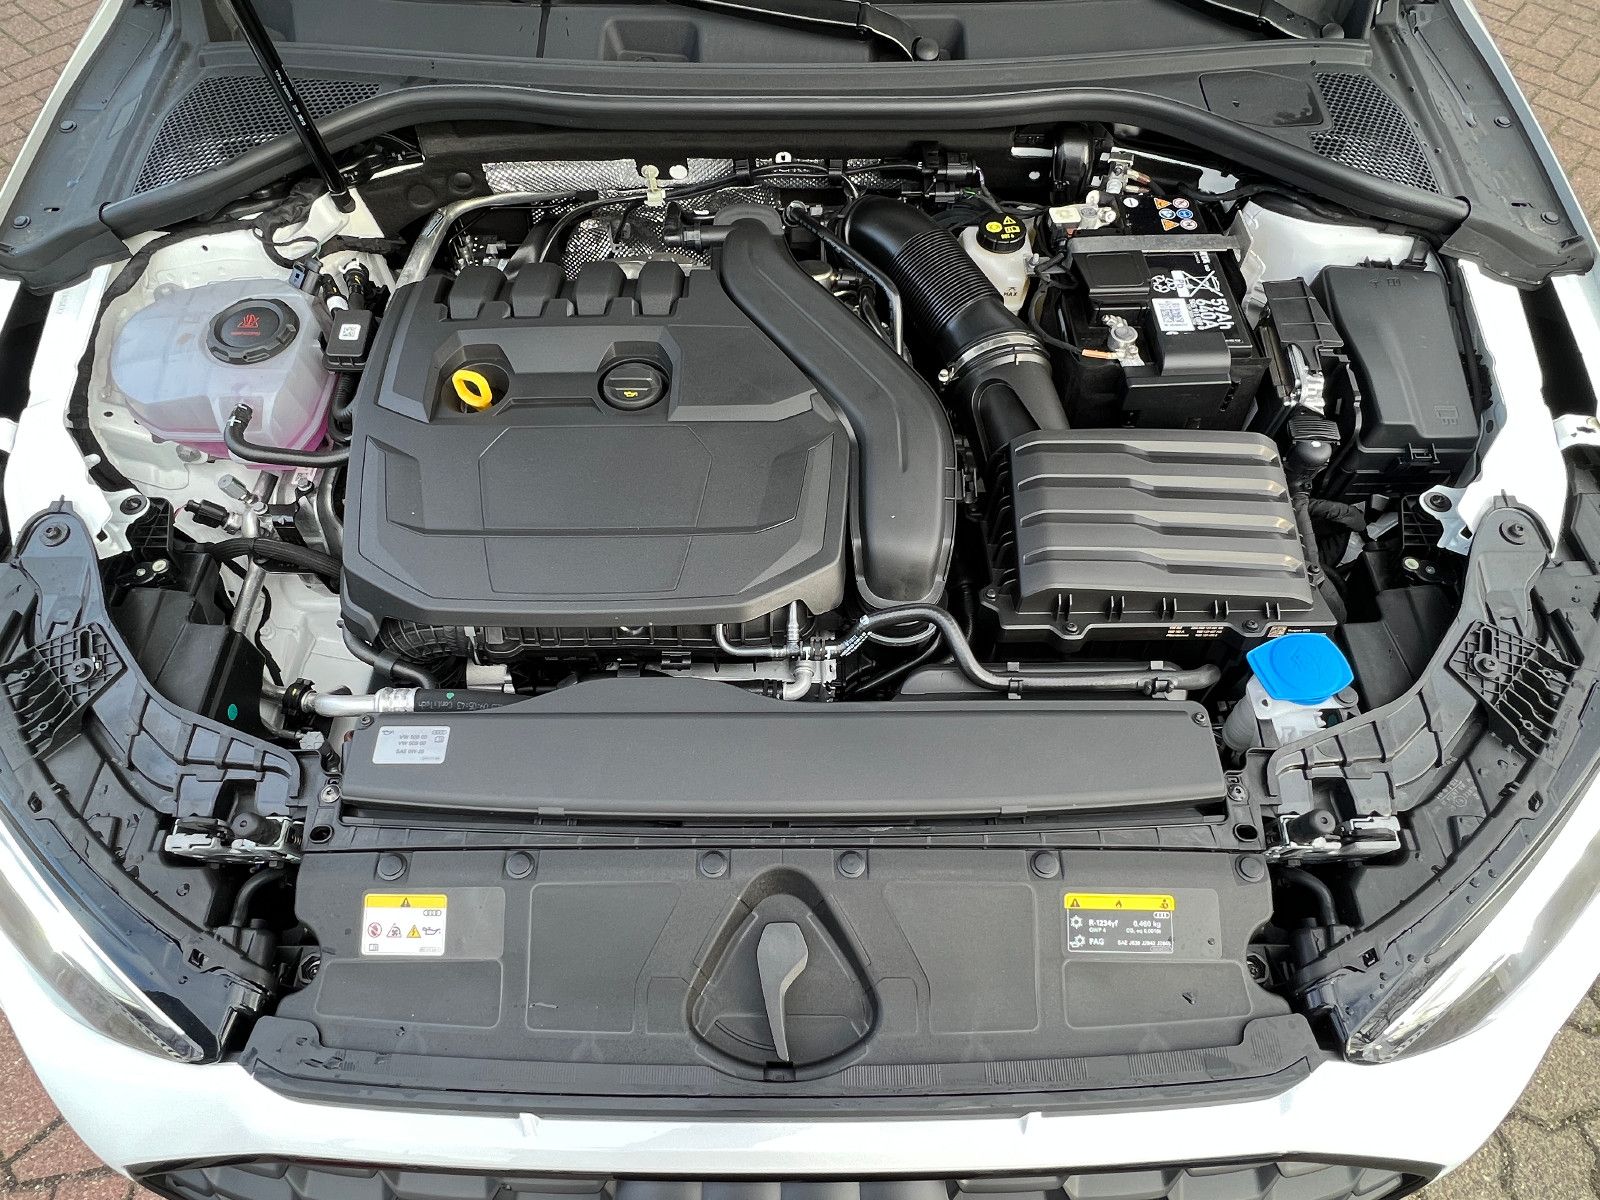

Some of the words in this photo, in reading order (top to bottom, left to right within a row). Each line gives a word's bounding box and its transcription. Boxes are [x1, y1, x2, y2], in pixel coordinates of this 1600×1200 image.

[1195, 298, 1221, 331] 640A
[1210, 298, 1235, 330] 59Ah
[1088, 919, 1119, 928] R-1234yf
[1152, 920, 1162, 929] kg
[1088, 937, 1105, 946] PAG
